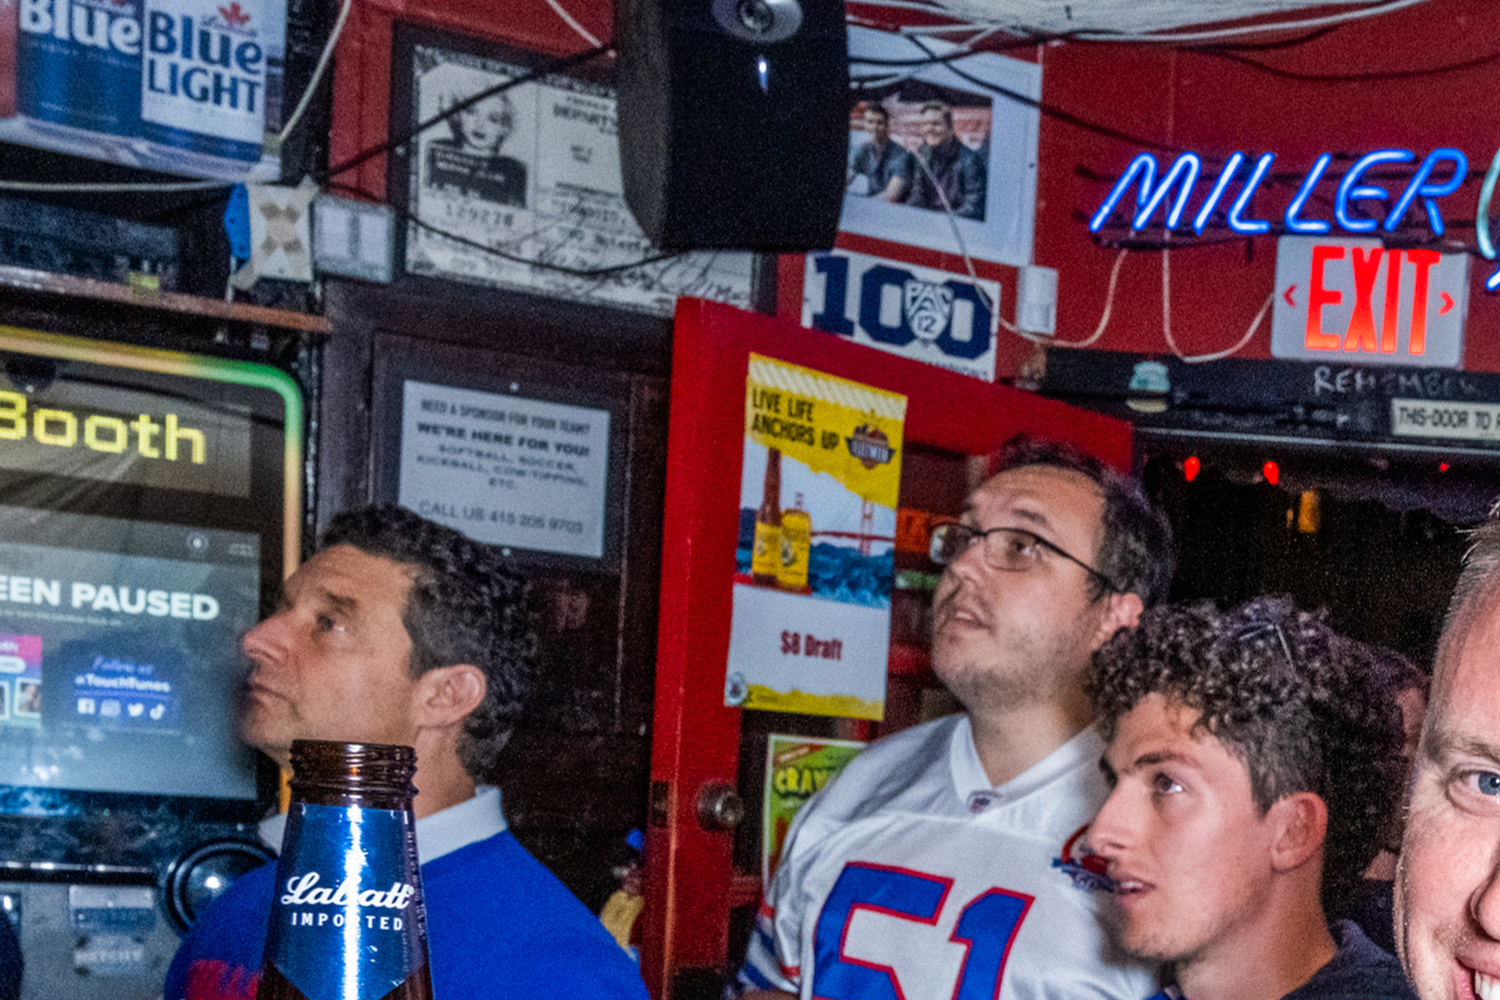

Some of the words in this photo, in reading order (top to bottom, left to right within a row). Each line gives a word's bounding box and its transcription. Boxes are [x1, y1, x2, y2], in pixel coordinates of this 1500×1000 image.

[149, 10, 262, 74] Blue
[149, 58, 261, 113] LIGHT
[1088, 147, 1468, 235] MILLER
[814, 256, 994, 360] 100
[1304, 245, 1441, 355] EXIT
[420, 398, 447, 415] NEED
[460, 404, 506, 423] SPONSOR
[509, 411, 528, 426] FOR
[531, 414, 557, 431] YOUR
[752, 388, 781, 415] LIVE
[787, 397, 814, 423] LIFE
[1475, 411, 1491, 430] TO
[0, 390, 206, 464] Booth
[417, 421, 467, 439] WE'RE
[471, 430, 513, 446] HERE
[518, 435, 549, 450] FOR
[751, 413, 816, 447] ANCHORS
[821, 430, 840, 451] UP
[419, 499, 458, 519] CALL
[463, 507, 485, 522] US
[71, 581, 221, 620] PAUSED
[781, 630, 801, 656] $8
[805, 634, 843, 661] Draft
[281, 871, 414, 909] Labatt
[292, 912, 403, 931] IMPOTED
